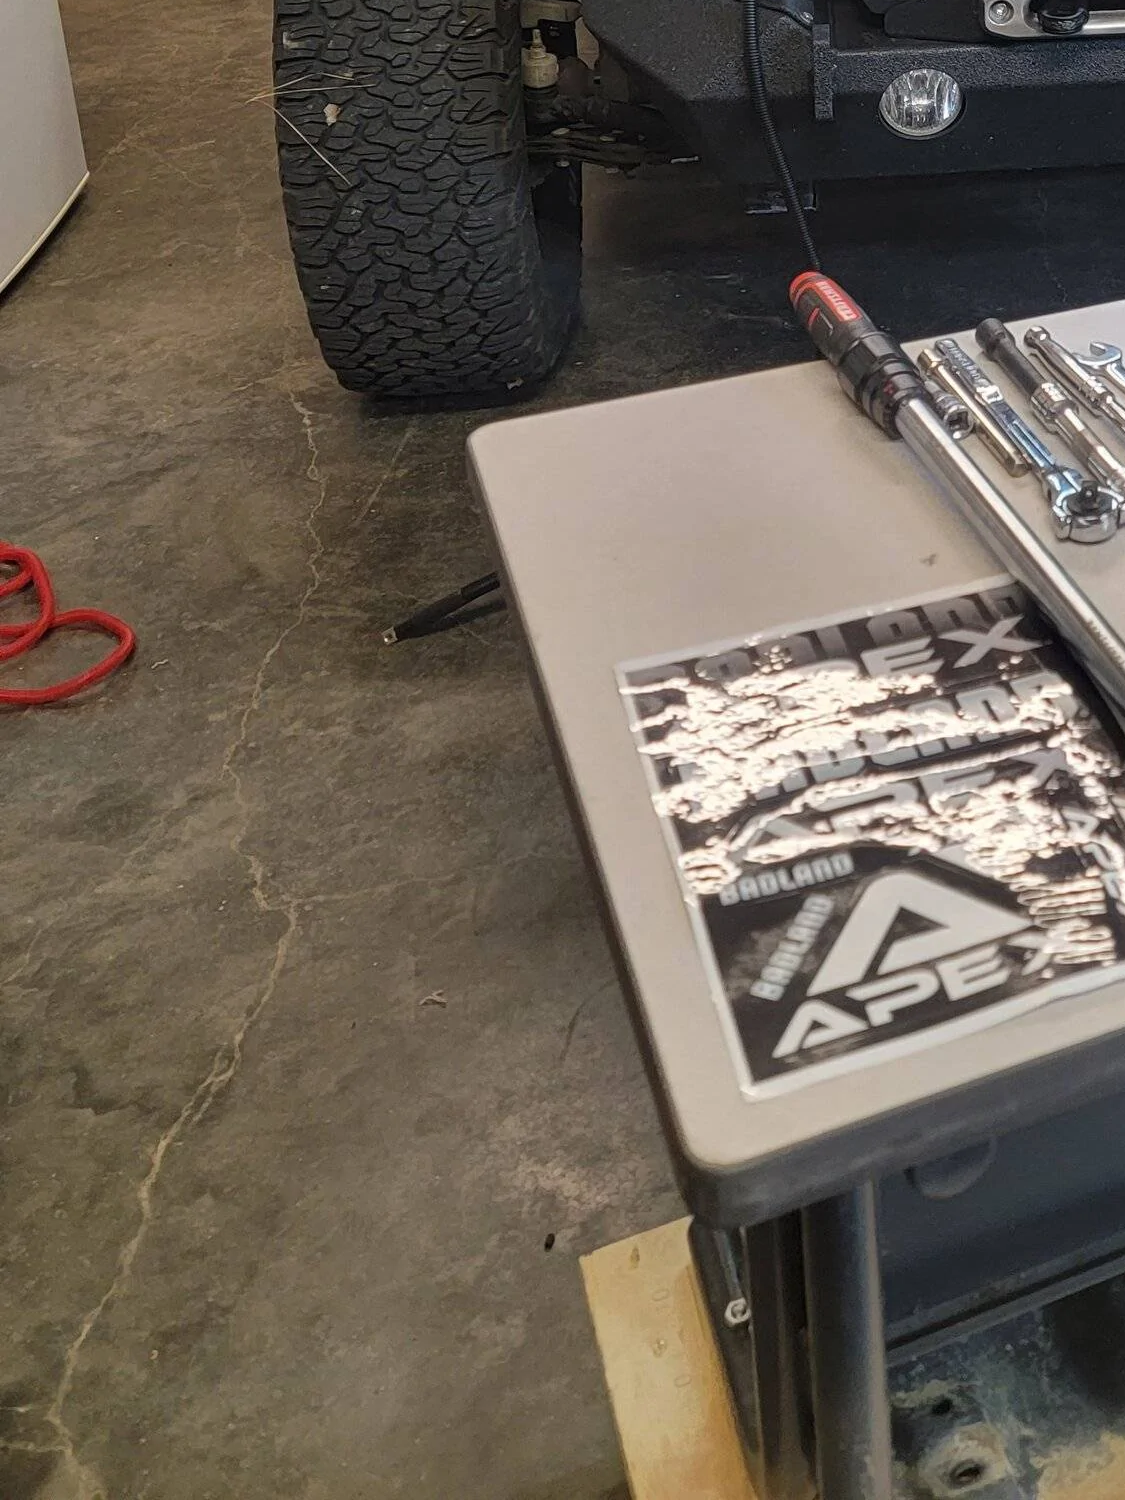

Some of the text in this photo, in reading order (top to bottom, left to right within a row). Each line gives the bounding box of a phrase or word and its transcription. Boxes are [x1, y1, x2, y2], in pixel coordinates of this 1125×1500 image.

[719, 852, 855, 907] BADLAND
[749, 892, 835, 1002] BADLAND
[771, 933, 1068, 1059] APEX
